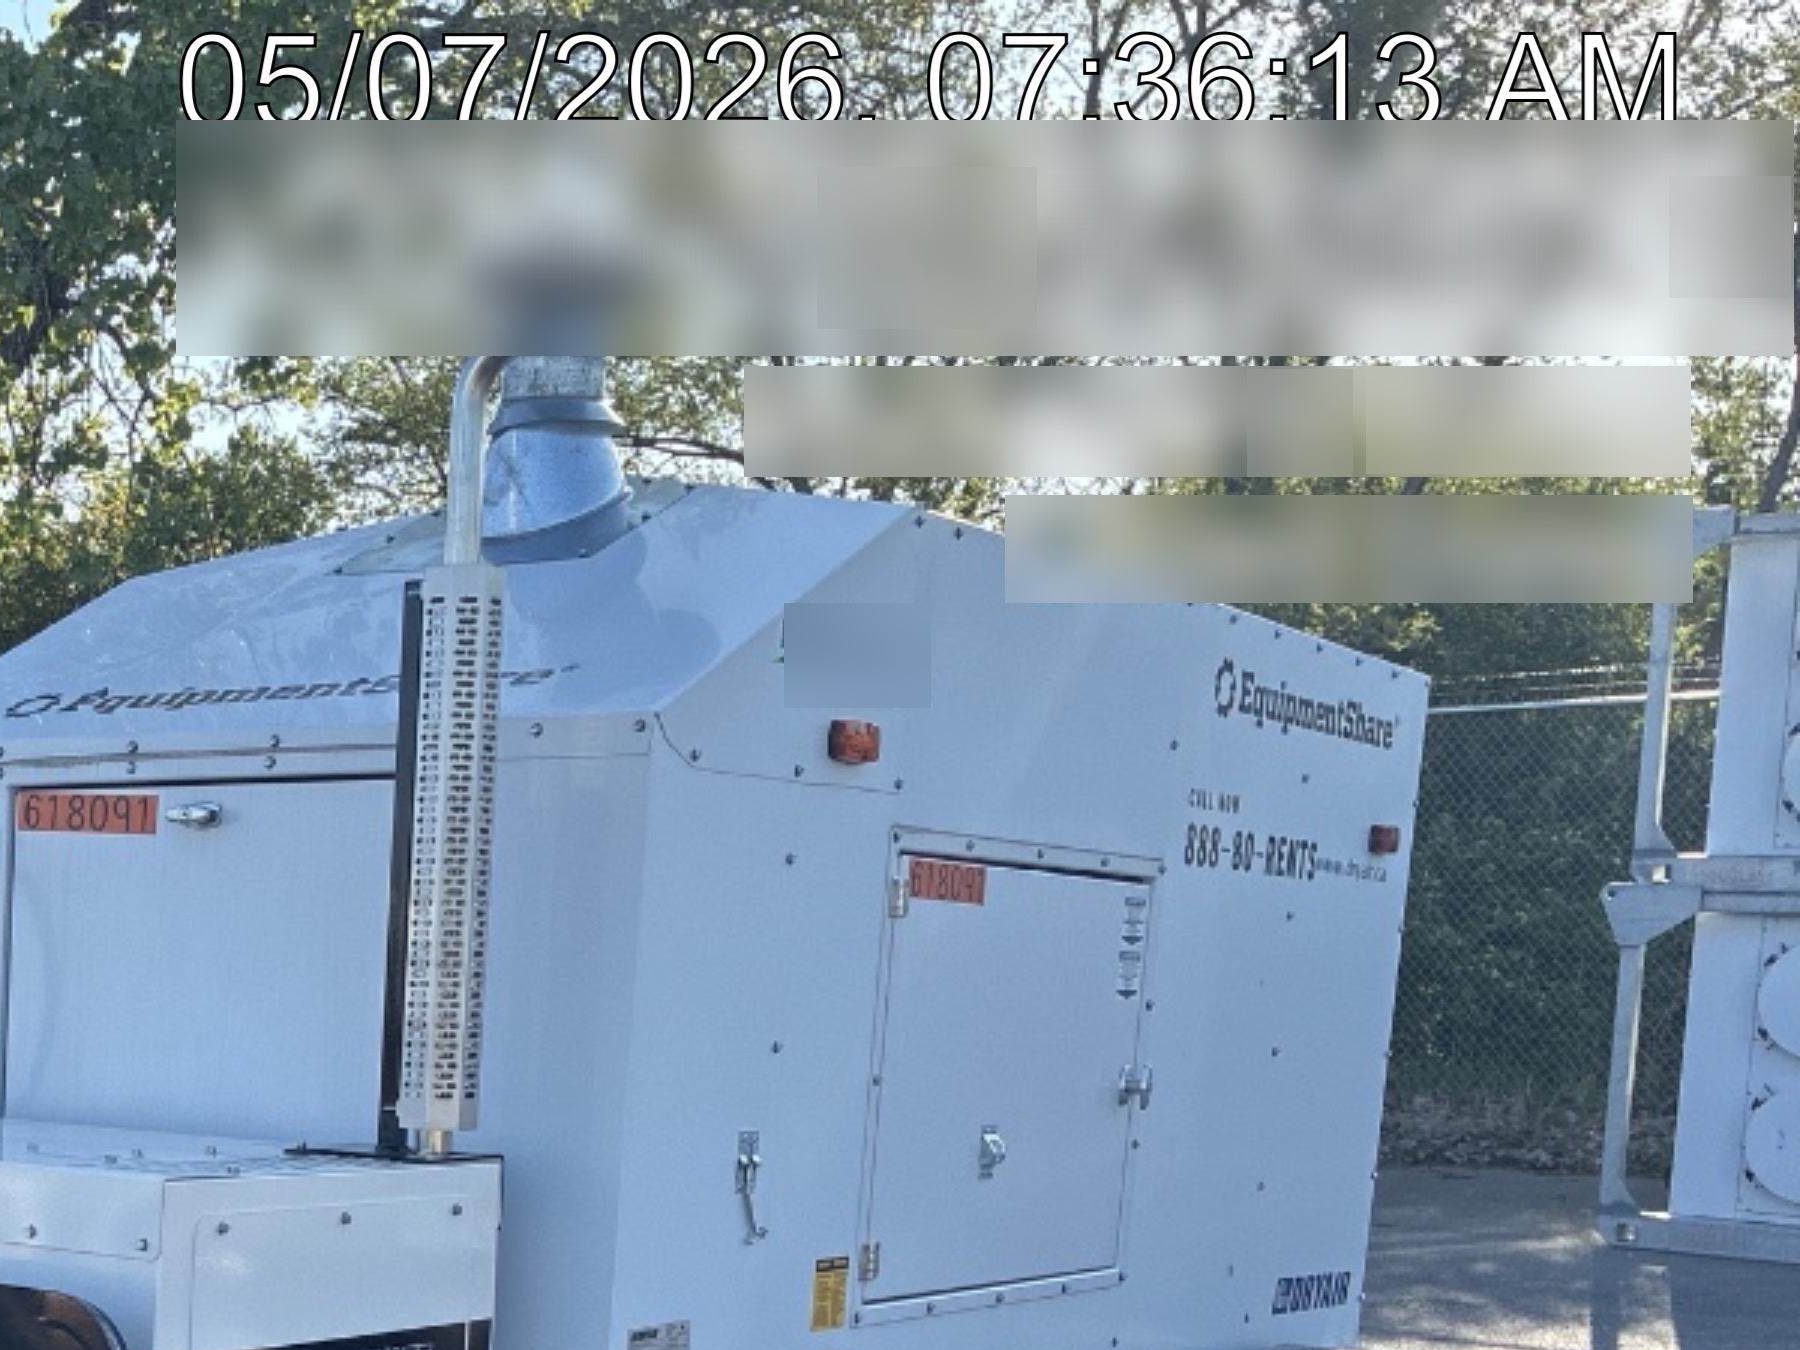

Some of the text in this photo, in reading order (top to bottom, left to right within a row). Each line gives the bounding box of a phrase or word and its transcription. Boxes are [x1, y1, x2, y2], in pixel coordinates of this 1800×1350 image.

[57, 667, 554, 713] EquipmentSe
[1238, 671, 1394, 749] EquipmentShare
[23, 794, 148, 833] 618091
[1184, 821, 1319, 881] 888-80-RENTS
